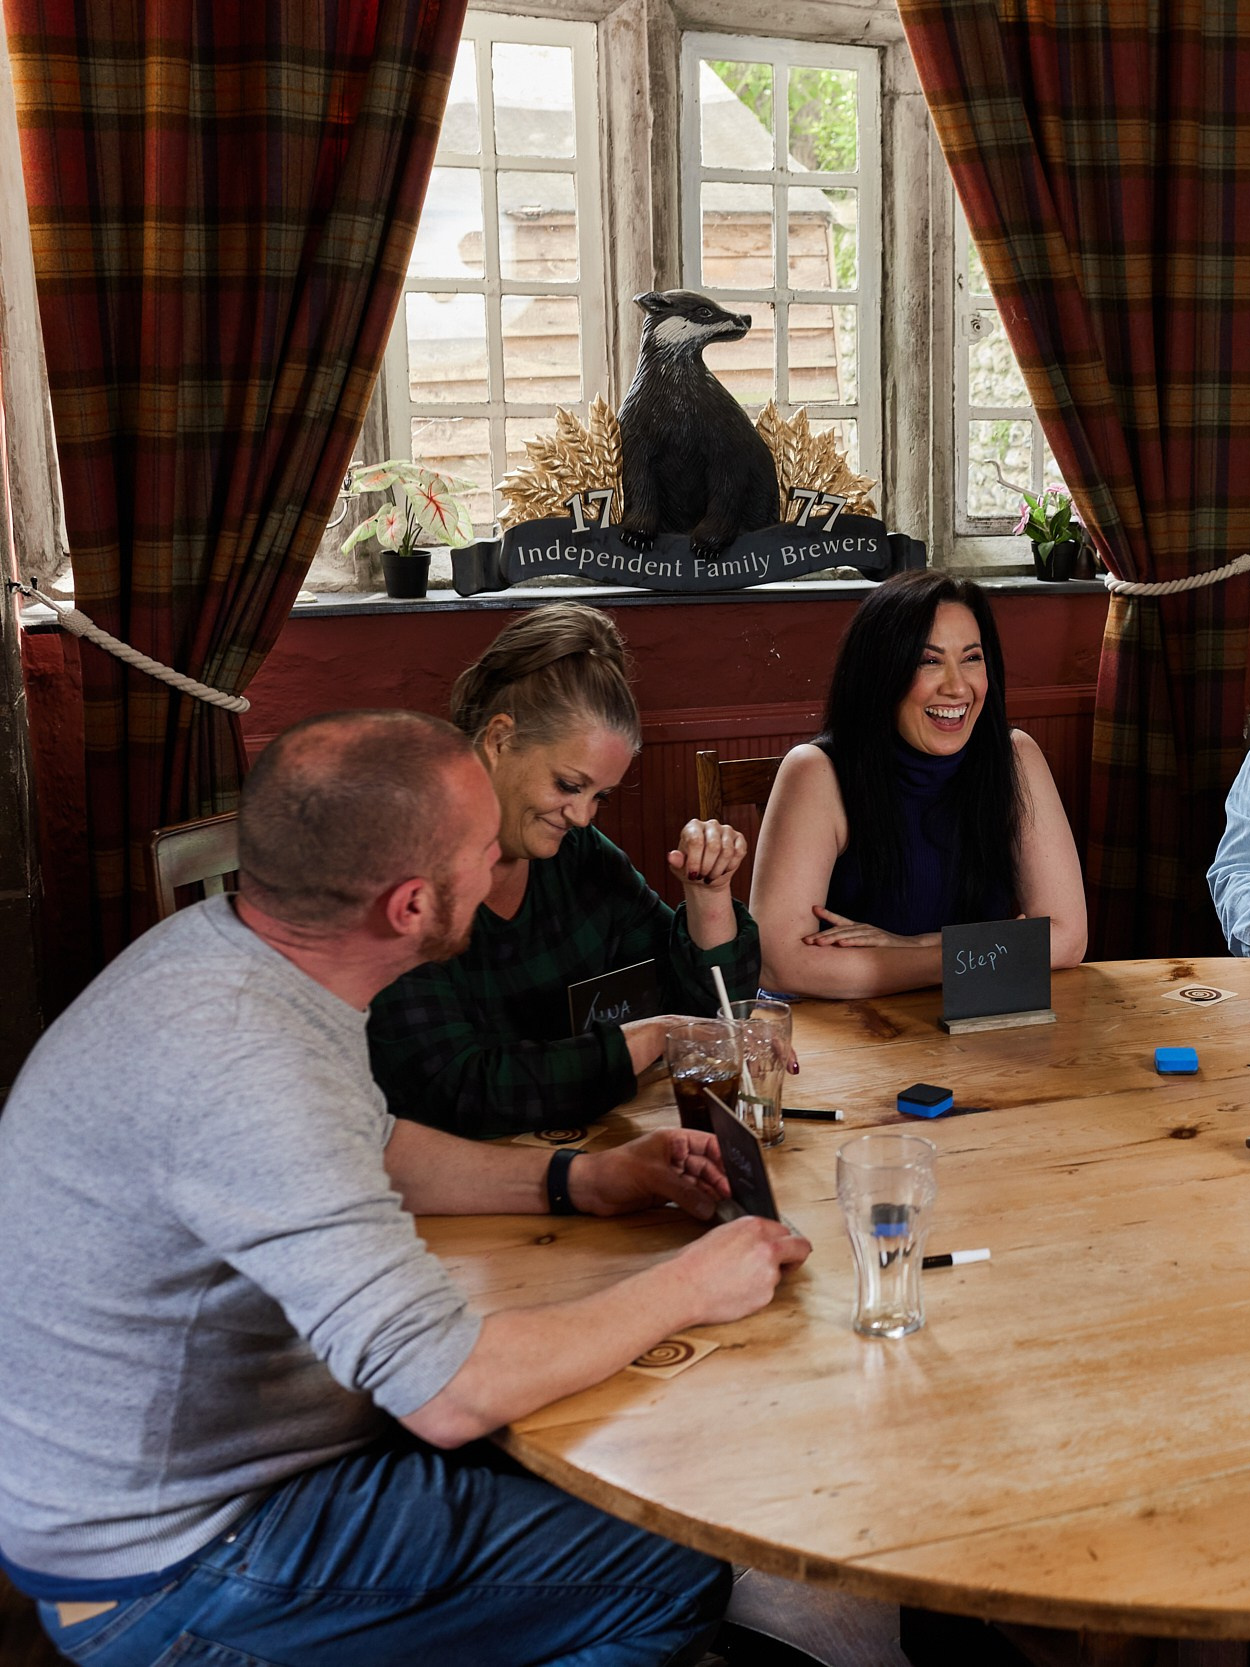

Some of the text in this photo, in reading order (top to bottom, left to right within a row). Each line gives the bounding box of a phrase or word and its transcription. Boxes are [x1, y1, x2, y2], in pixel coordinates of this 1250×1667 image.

[565, 488, 848, 534] 17 77
[518, 537, 878, 579] Independent Family Brewers
[955, 943, 1008, 975] Steph
